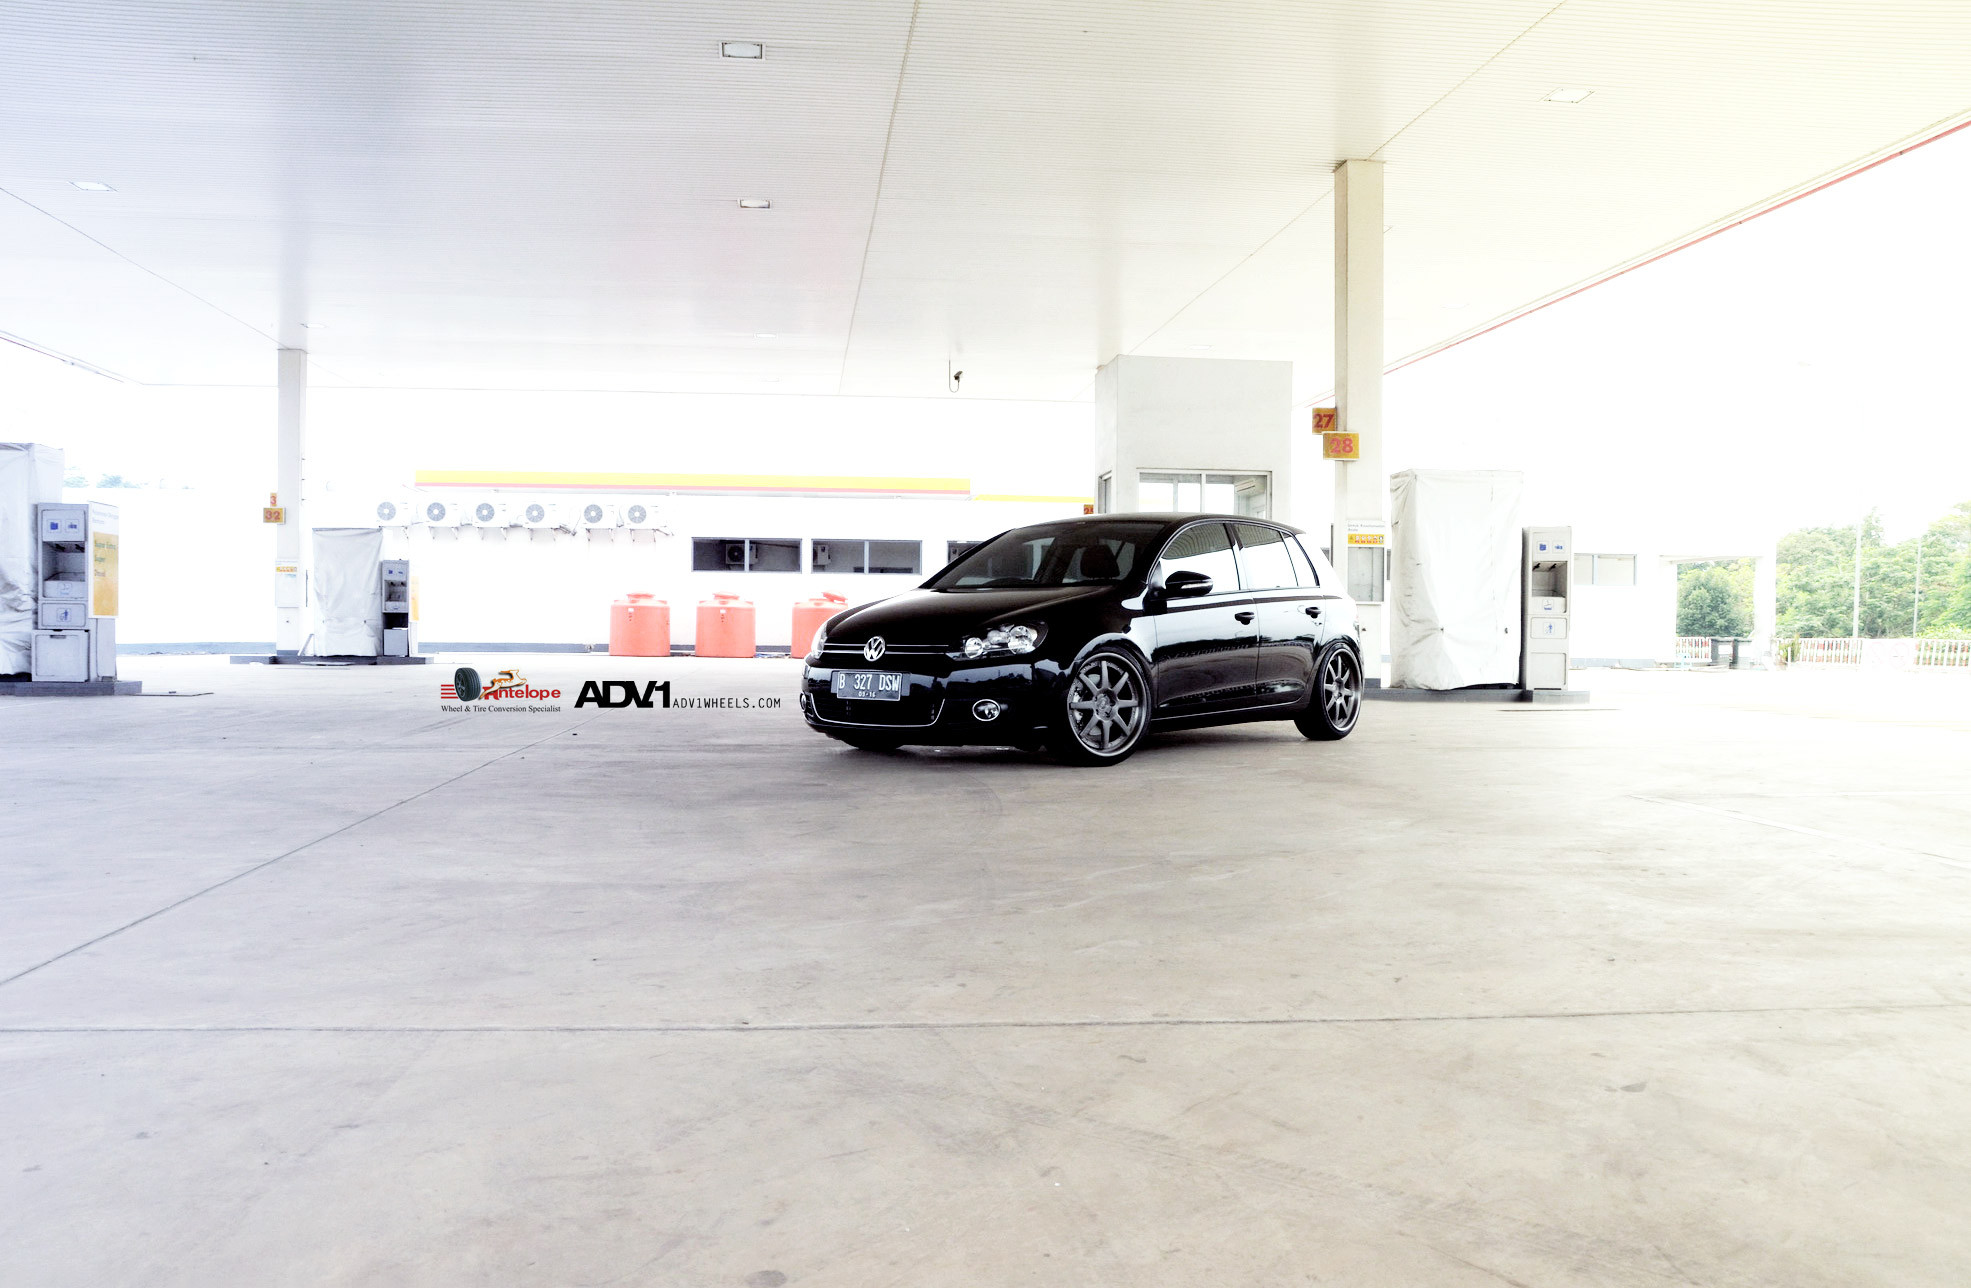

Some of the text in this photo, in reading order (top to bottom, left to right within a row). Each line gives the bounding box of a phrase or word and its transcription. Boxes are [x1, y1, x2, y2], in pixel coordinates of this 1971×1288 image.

[1313, 413, 1335, 429] 27
[1330, 437, 1353, 453] 28
[265, 510, 280, 520] 32
[839, 673, 900, 691] B 327 DSW
